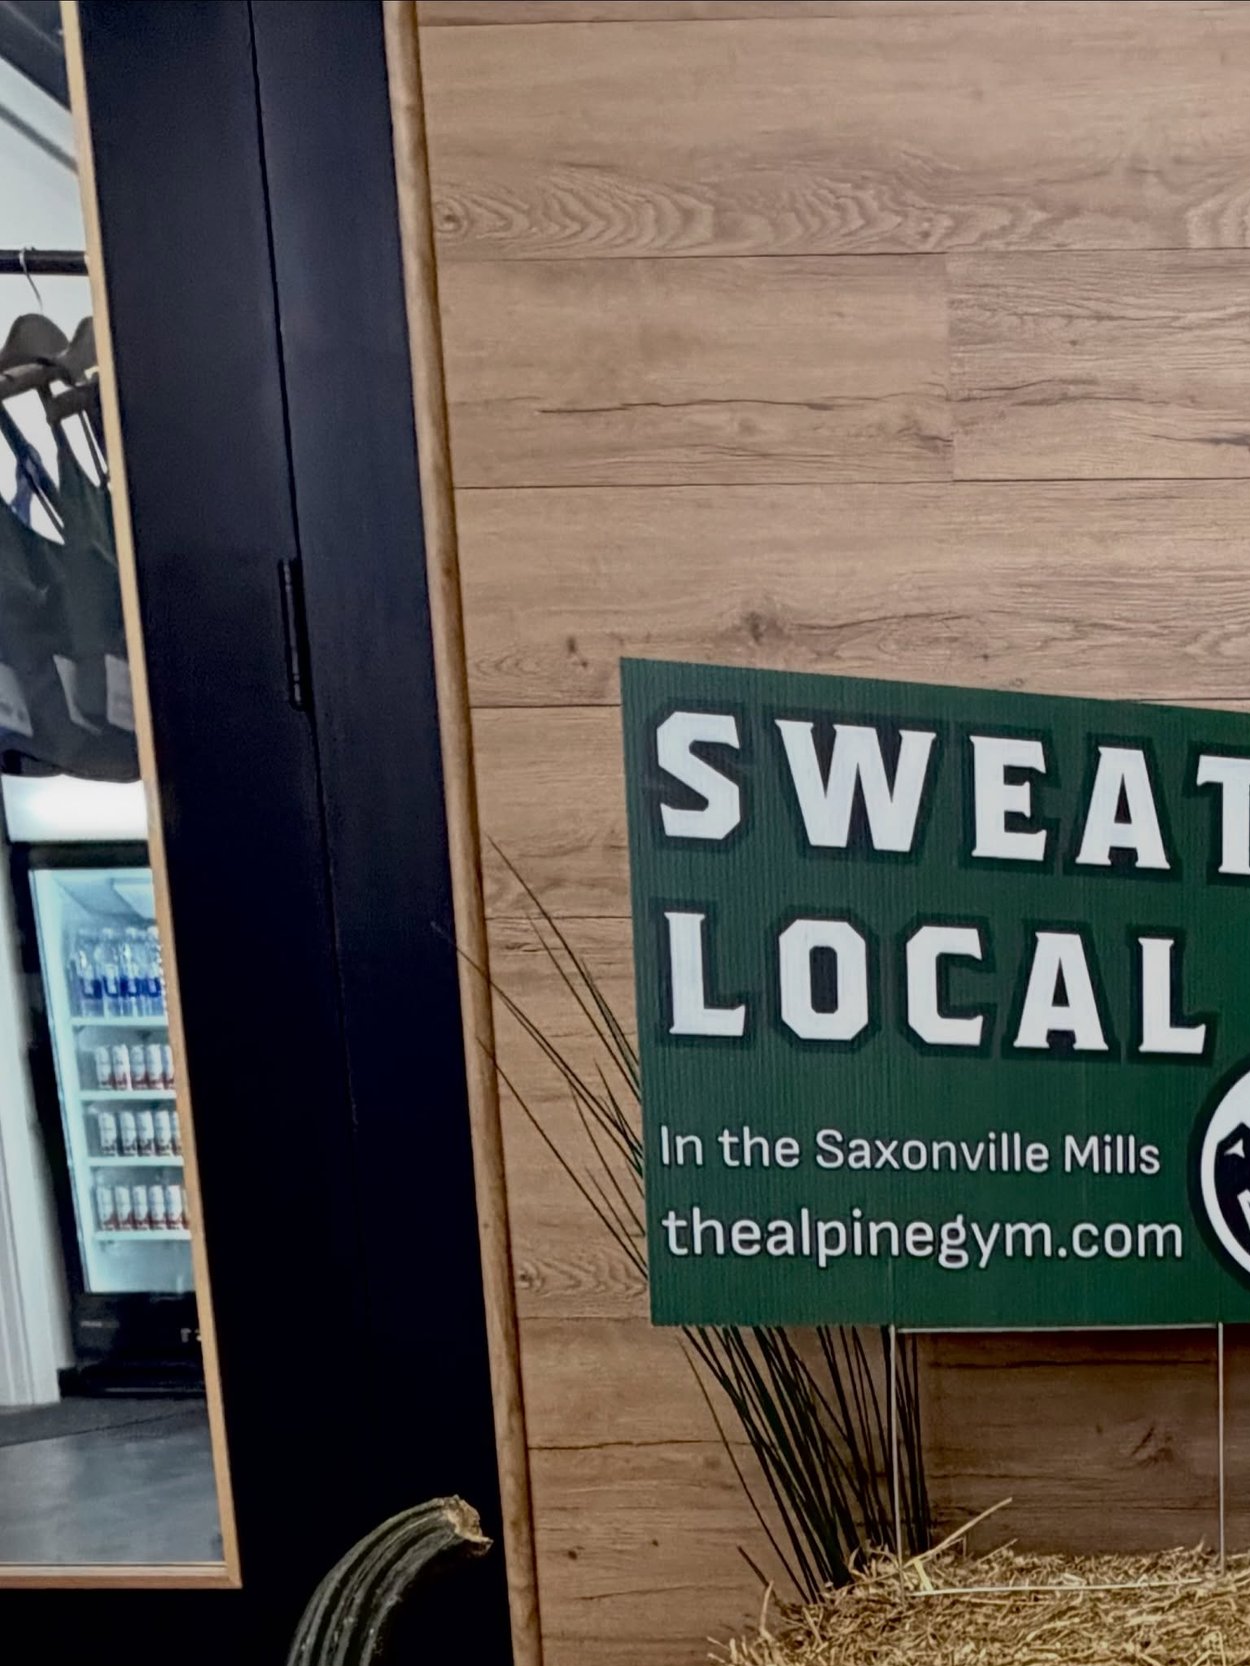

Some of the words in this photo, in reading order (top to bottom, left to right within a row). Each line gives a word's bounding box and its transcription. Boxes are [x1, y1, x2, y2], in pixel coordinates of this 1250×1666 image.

[663, 911, 1207, 1055] LOCAL
[660, 1125, 703, 1168] In
[717, 1126, 800, 1169] the
[815, 1128, 1050, 1173] Saxonville
[1064, 1134, 1161, 1175] Mills
[660, 1206, 1183, 1269] thealpinegym.com
